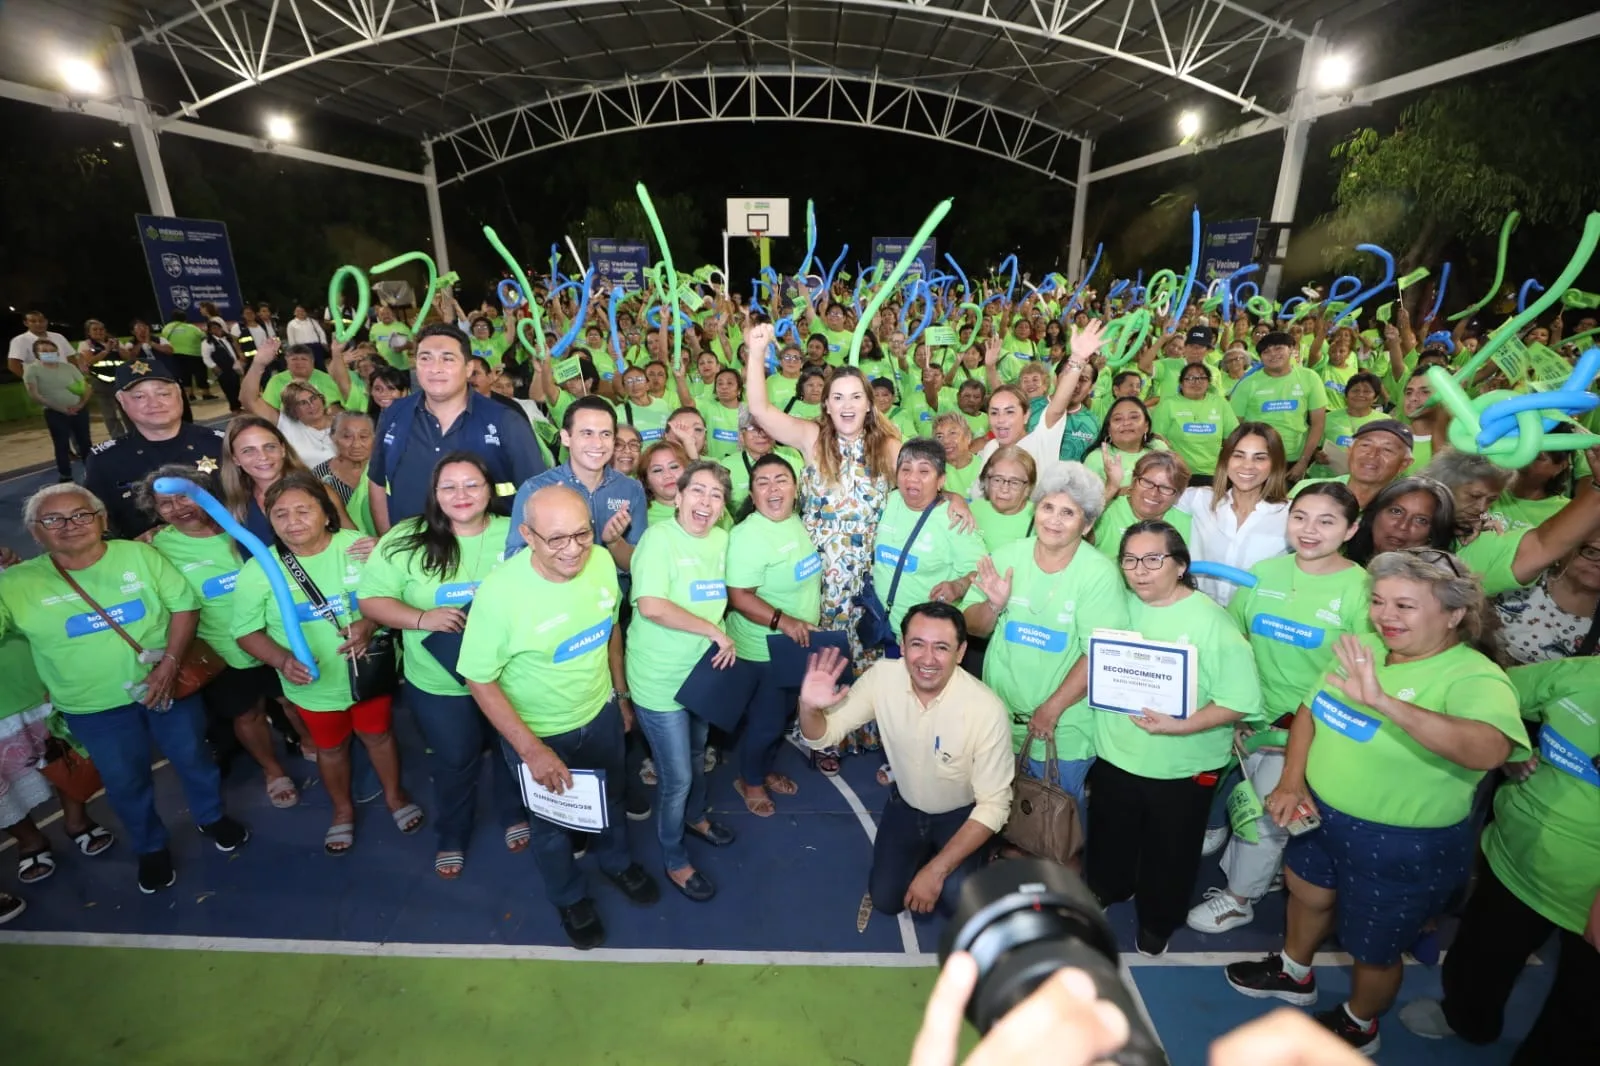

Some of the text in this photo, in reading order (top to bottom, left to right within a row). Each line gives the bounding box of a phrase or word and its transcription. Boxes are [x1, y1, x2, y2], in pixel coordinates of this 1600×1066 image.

[181, 255, 219, 265] Vecinos
[1216, 259, 1240, 269] Vecinos
[568, 629, 606, 652] GRANJAS
[1103, 664, 1173, 681] RECONOCIMIENTO
[1549, 750, 1584, 774] VERGEL
